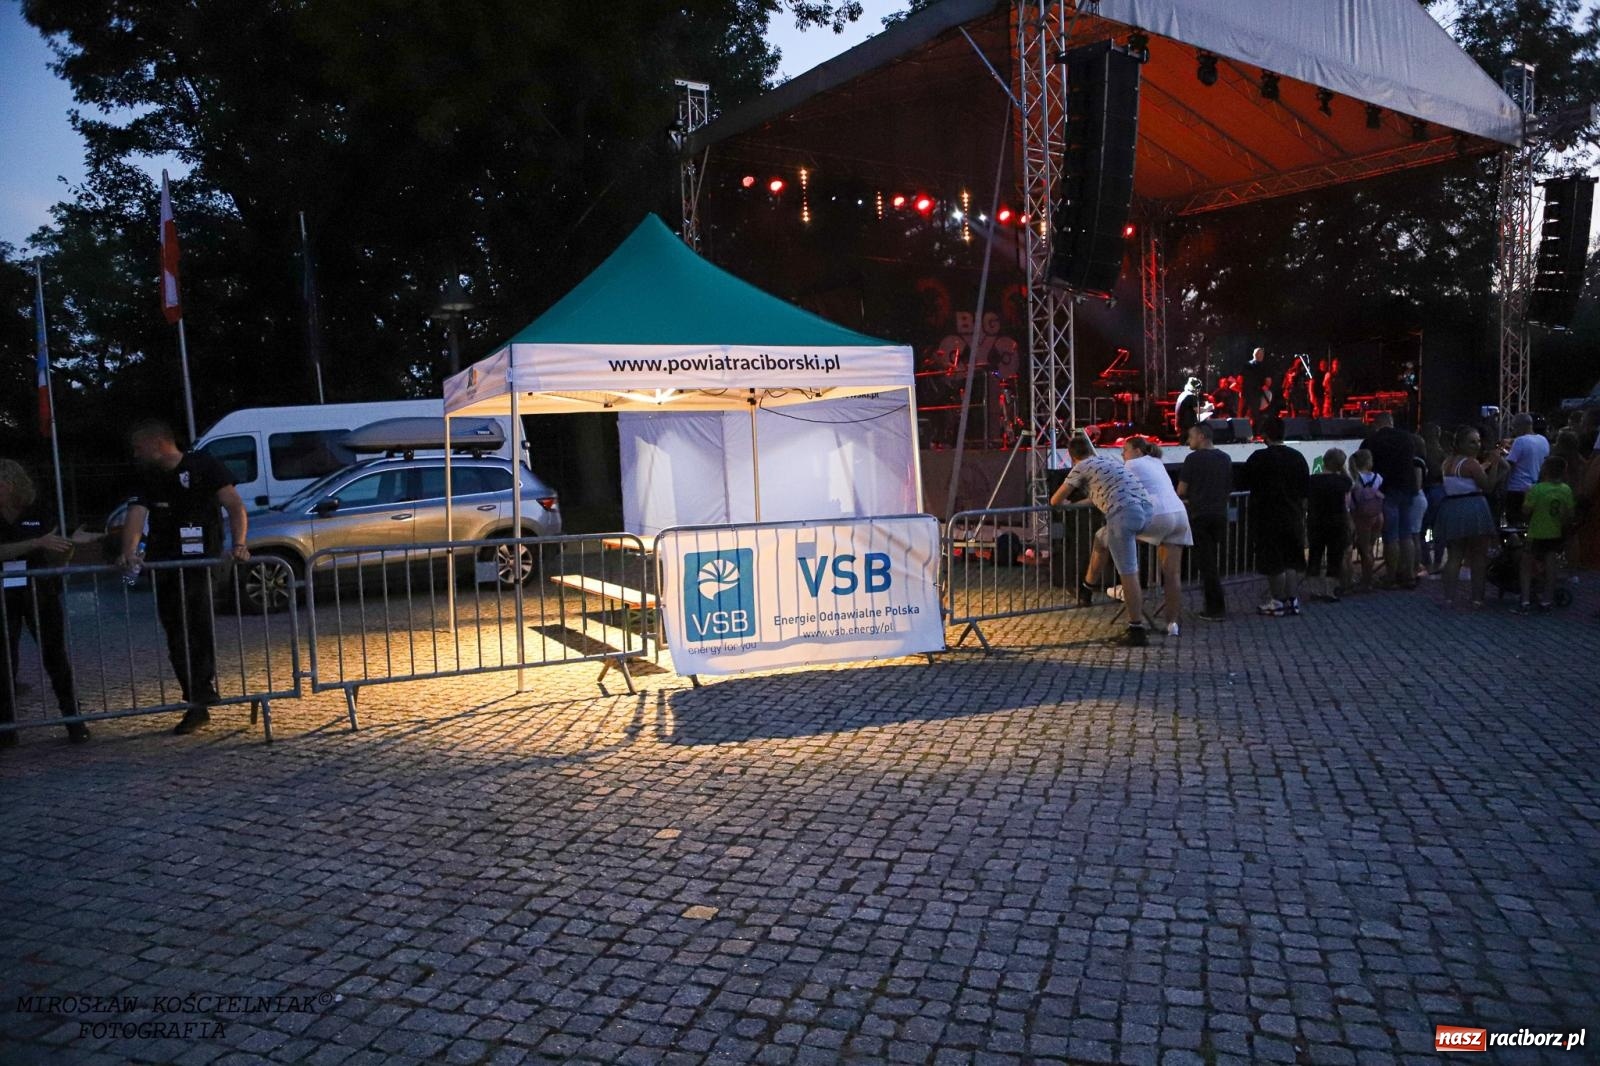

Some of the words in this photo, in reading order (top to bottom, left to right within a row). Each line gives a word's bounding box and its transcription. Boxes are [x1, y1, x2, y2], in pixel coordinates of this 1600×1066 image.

[956, 310, 1001, 335] BG
[608, 354, 841, 375] www.powiatraciborski.pl
[798, 552, 893, 599] VSB
[691, 609, 749, 636] VSB
[774, 612, 816, 627] Energie
[819, 607, 882, 622] Odnawialne
[885, 604, 920, 617] Polska
[803, 621, 894, 639] www.vsb.energy/pl
[688, 645, 721, 656] energy
[724, 641, 739, 652] for
[740, 641, 758, 653] you
